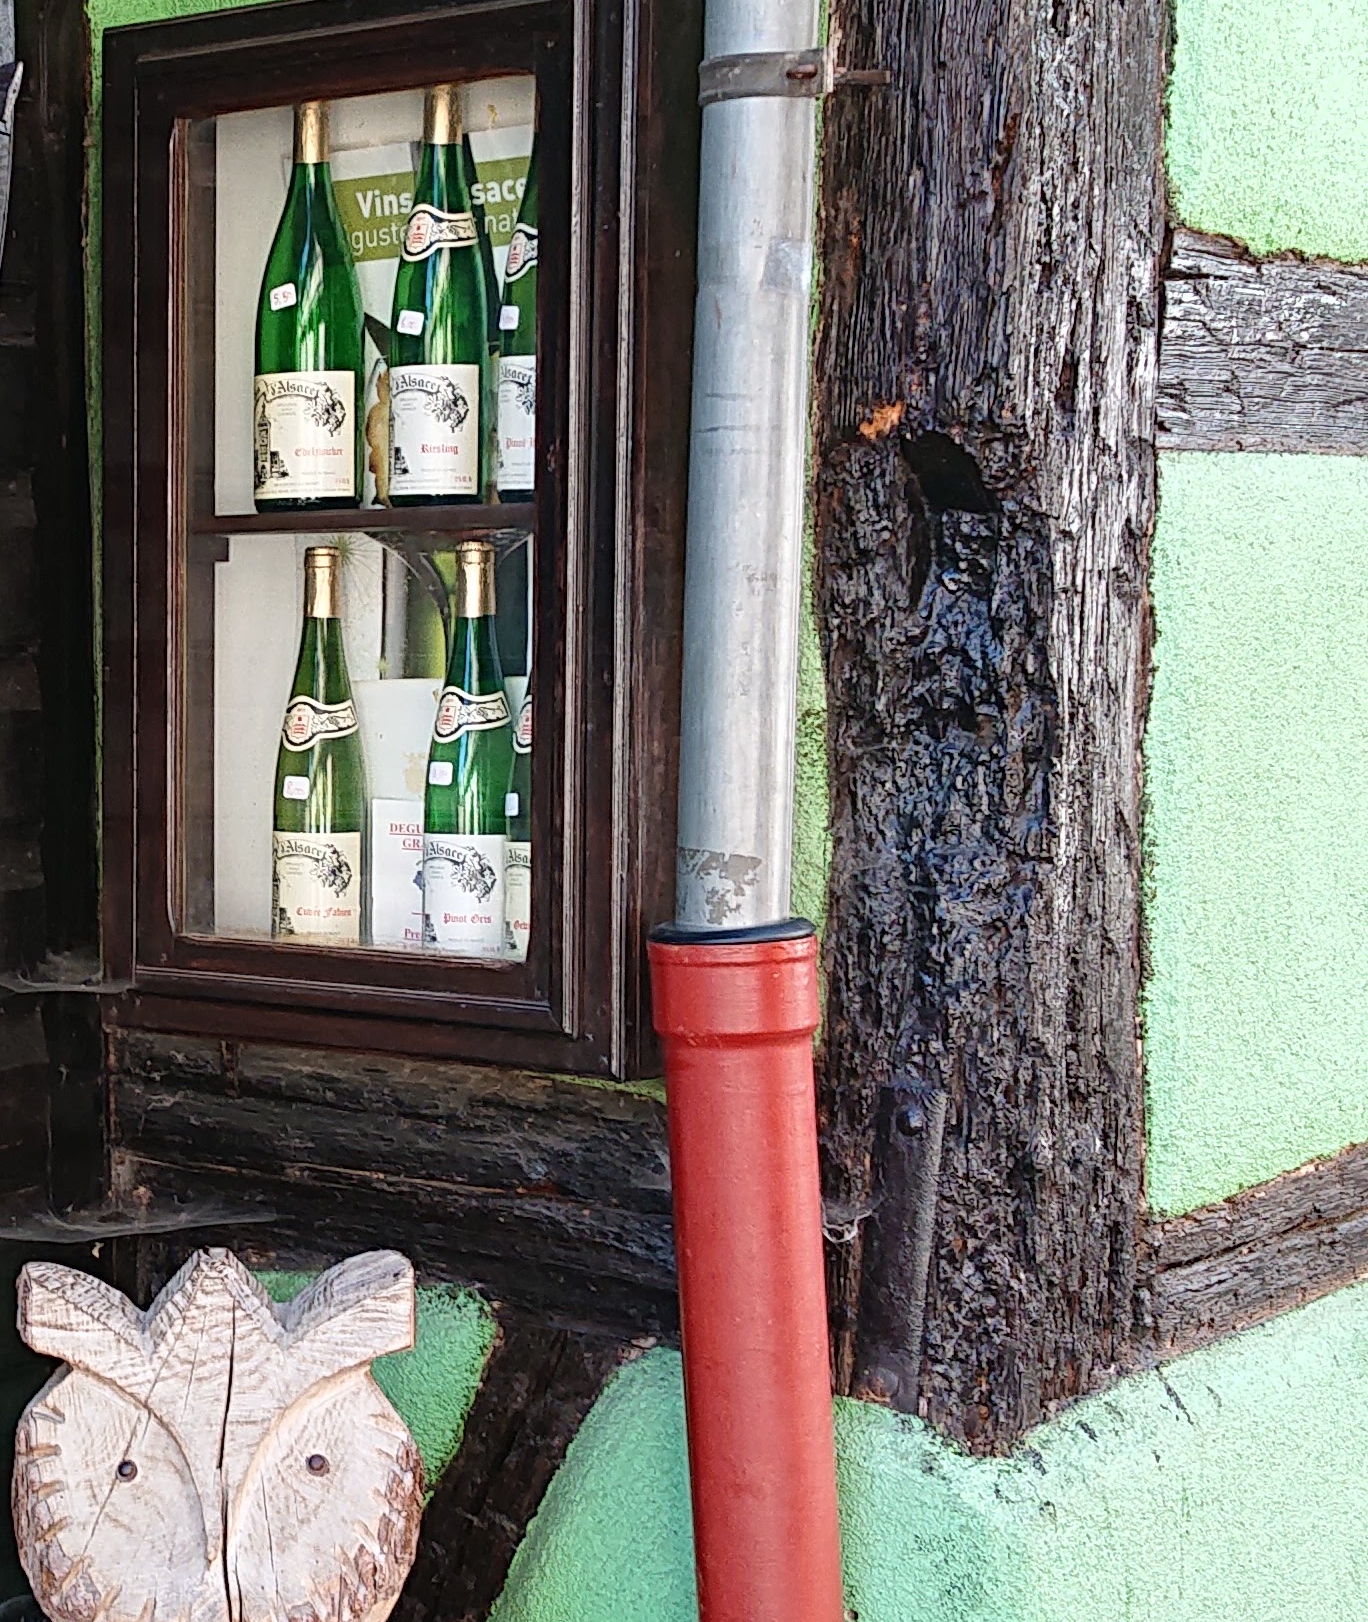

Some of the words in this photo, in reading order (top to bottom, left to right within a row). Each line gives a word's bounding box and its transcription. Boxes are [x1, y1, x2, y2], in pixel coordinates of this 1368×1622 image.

[356, 189, 412, 219] Vins
[420, 444, 459, 455] Riesling
[443, 912, 468, 924] Pinot
[471, 914, 492, 923] Gris
